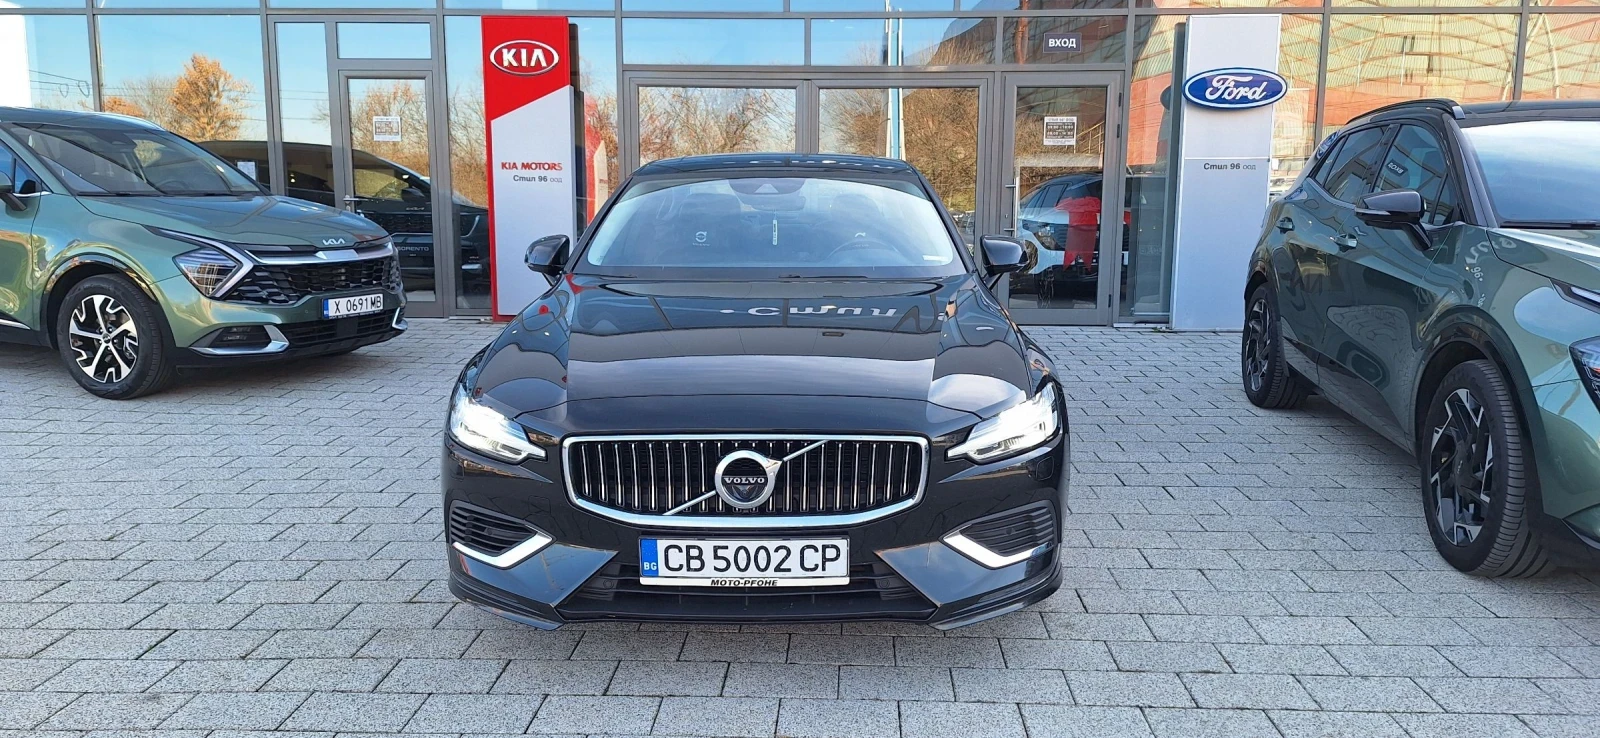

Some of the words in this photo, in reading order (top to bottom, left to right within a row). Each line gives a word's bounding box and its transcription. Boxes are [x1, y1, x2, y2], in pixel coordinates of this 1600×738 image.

[1048, 38, 1077, 48] ВХОД
[502, 48, 548, 67] KIA
[1205, 75, 1268, 100] Ford
[501, 162, 518, 170] KIA
[520, 162, 563, 170] MOTORS
[1230, 162, 1241, 170] 96
[334, 300, 341, 314] X
[346, 296, 369, 312] 0691
[663, 544, 706, 572] CB
[713, 544, 792, 573] 5002
[799, 544, 841, 572] CP
[643, 561, 658, 571] BG
[710, 578, 778, 587] MOTO-PFOHE
